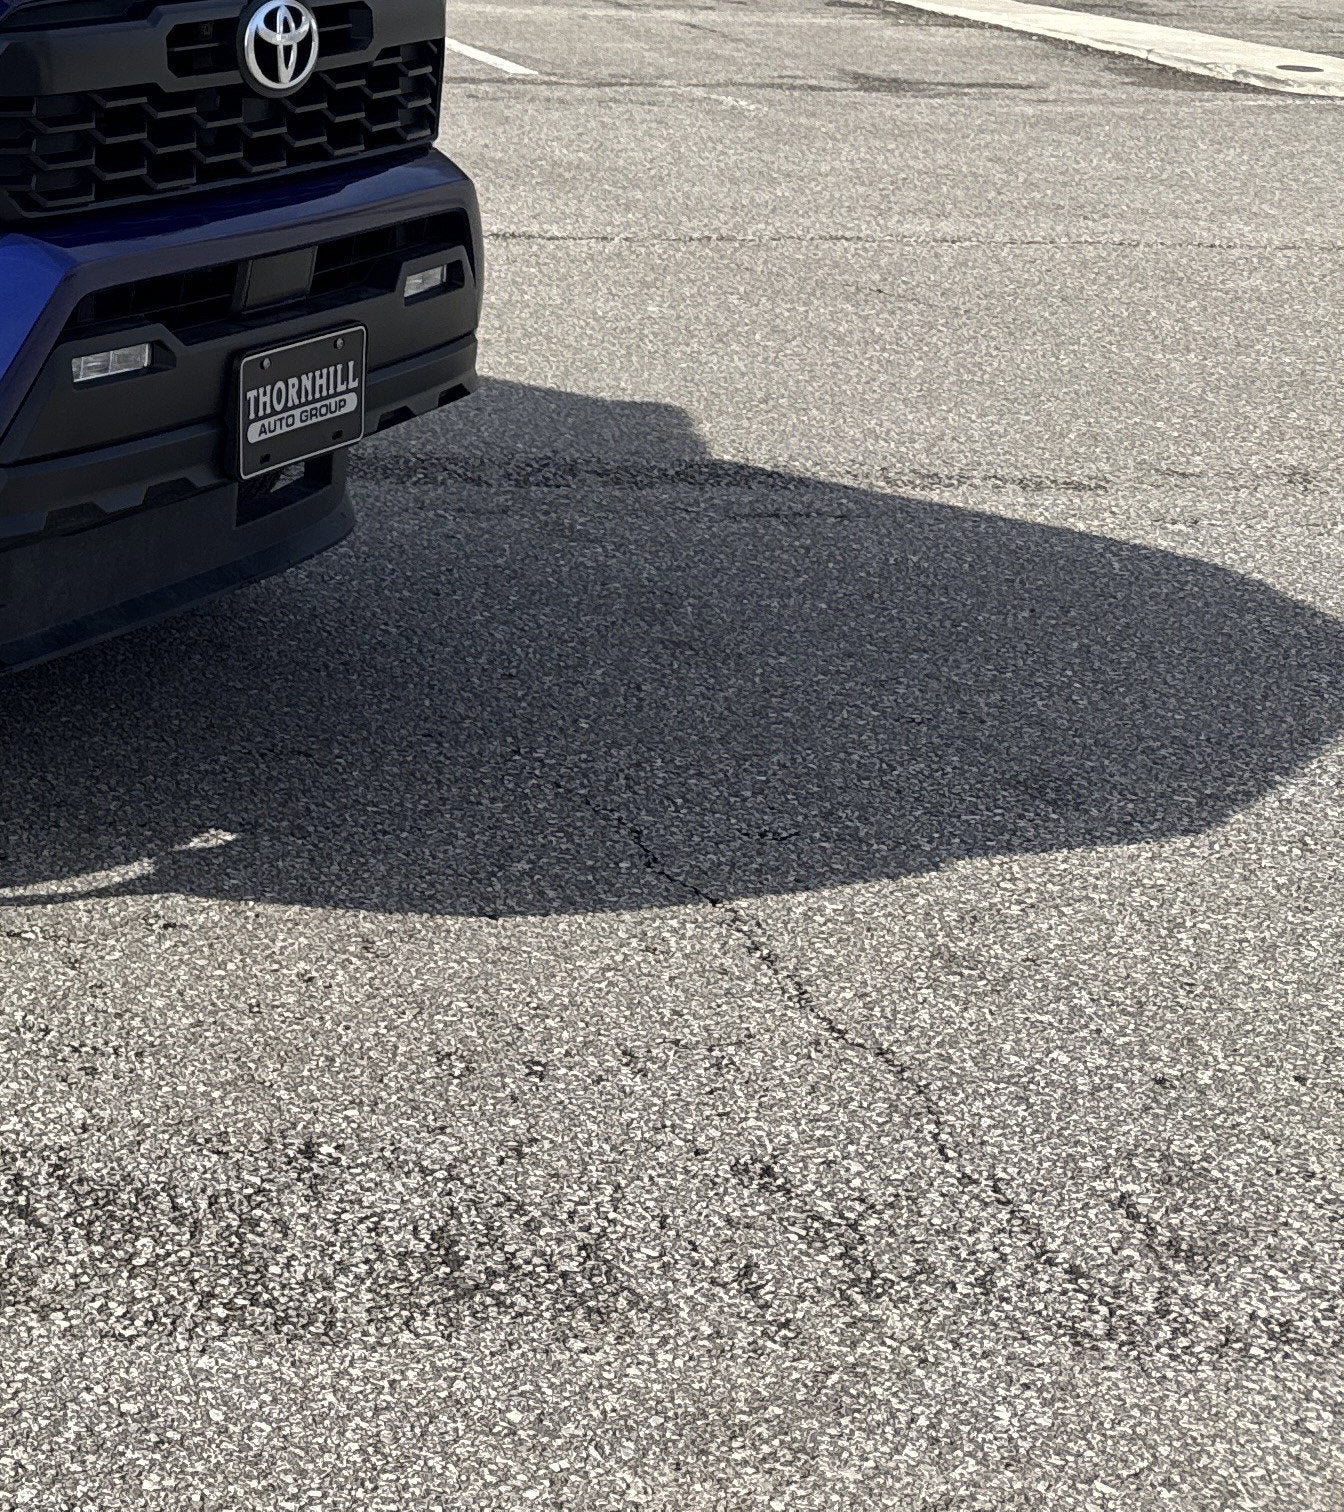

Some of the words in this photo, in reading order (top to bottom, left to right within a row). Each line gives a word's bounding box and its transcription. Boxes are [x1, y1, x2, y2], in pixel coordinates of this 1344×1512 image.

[246, 360, 359, 420] THORNHILL
[258, 414, 296, 438] AUTO
[300, 398, 347, 423] GROUP
